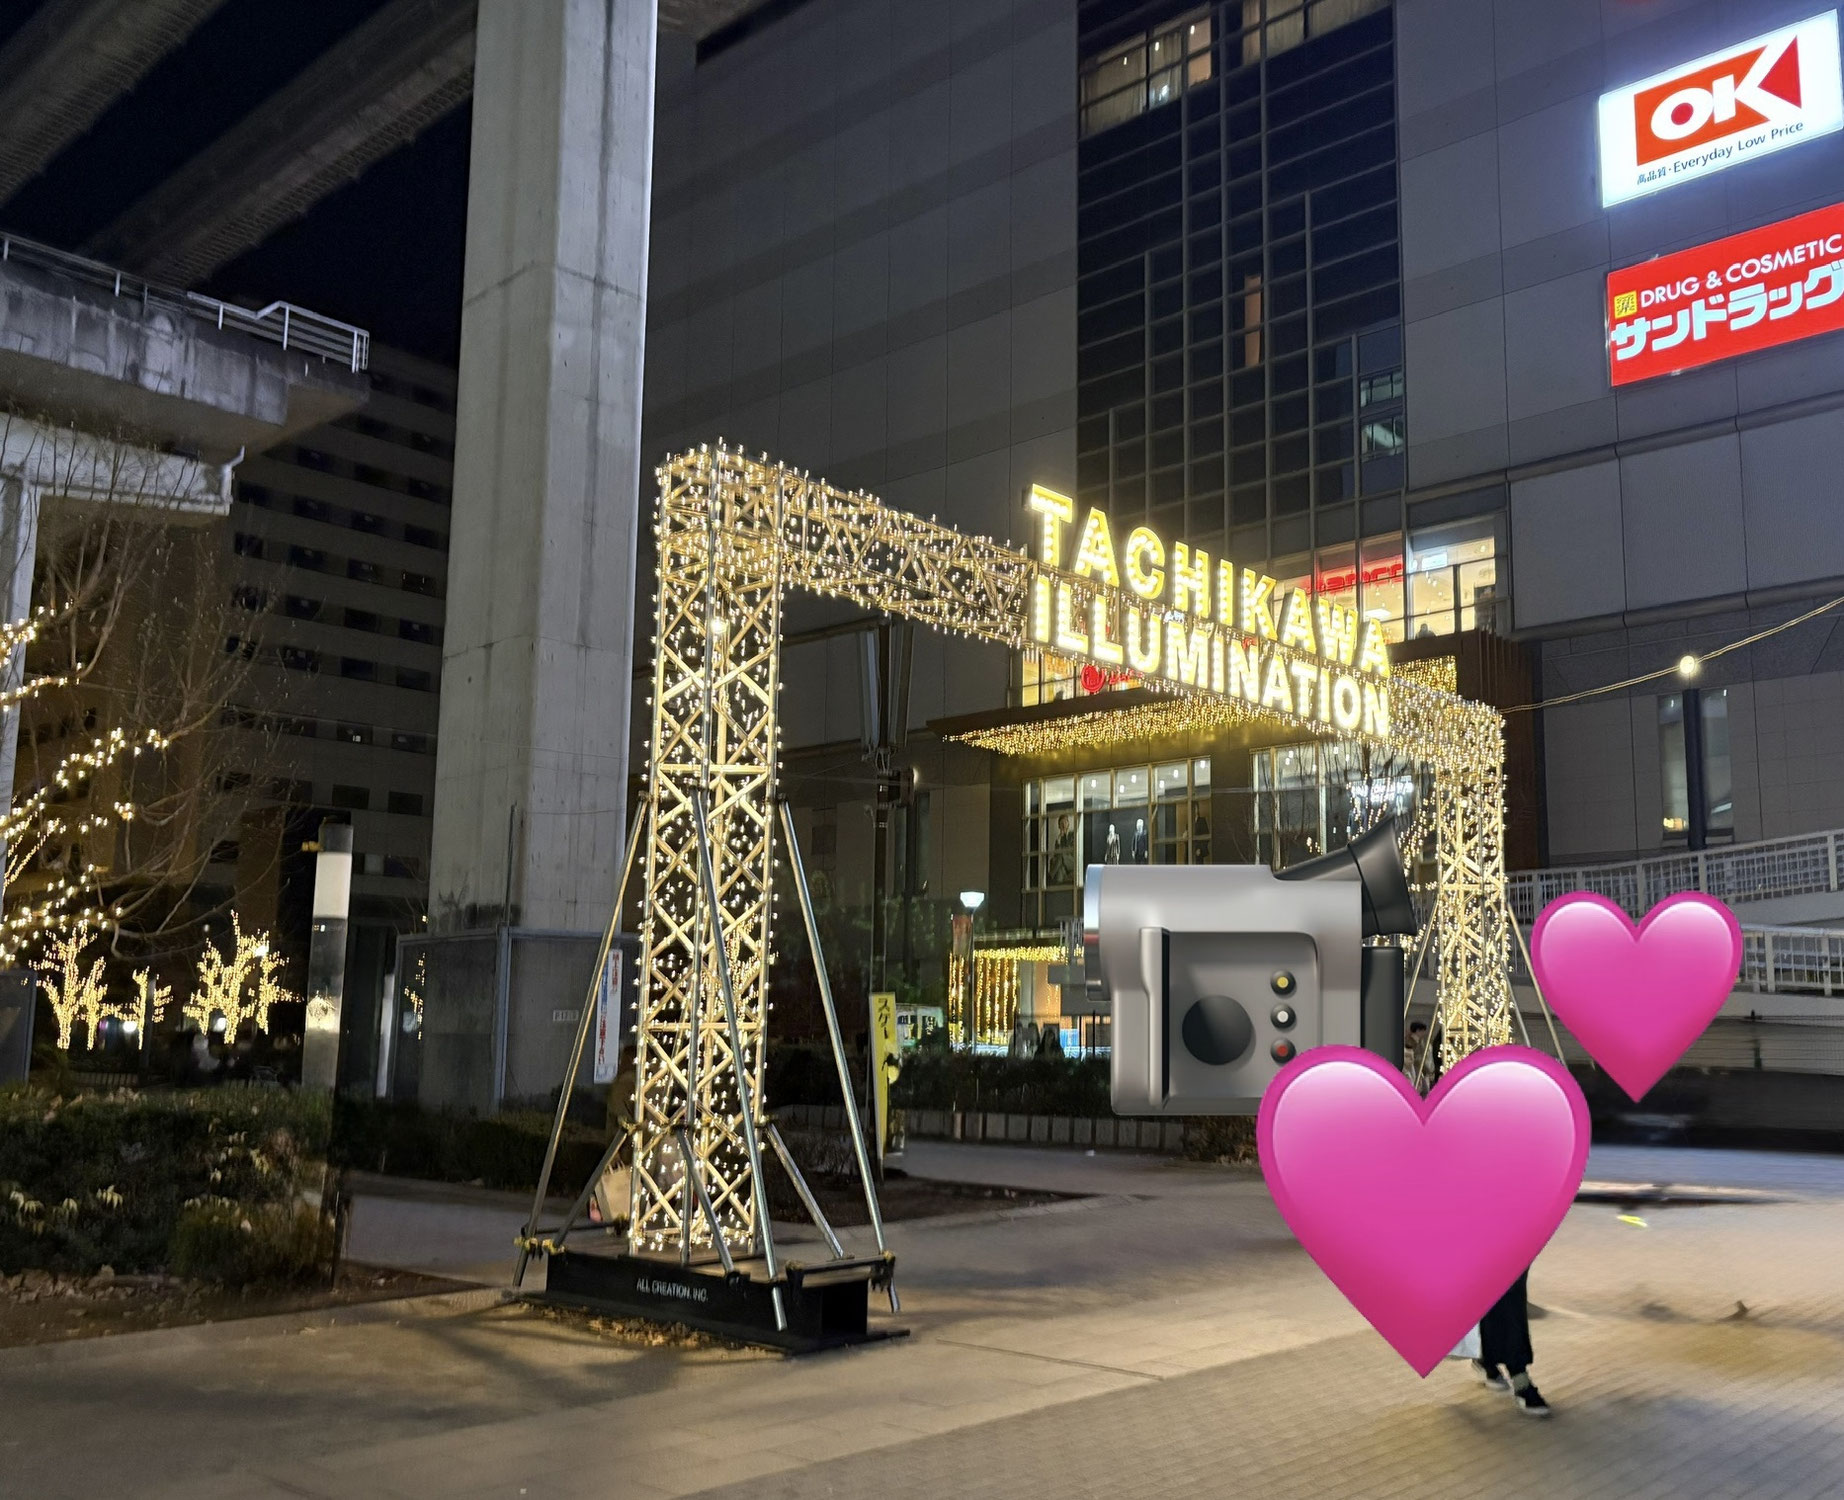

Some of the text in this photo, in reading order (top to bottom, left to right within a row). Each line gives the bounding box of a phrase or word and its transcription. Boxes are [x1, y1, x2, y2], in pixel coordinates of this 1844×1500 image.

[1651, 36, 1800, 141] OK
[1673, 145, 1733, 174] Everyday
[1738, 134, 1766, 152] Low
[1771, 121, 1804, 140] Price
[1611, 258, 1844, 361] サンドラッグ
[1641, 234, 1843, 308] DRUG & COSMETIC
[1030, 483, 1391, 678] TACHIKAWA
[1034, 575, 1390, 738] ILLUMINATION
[636, 1278, 650, 1293] ALL
